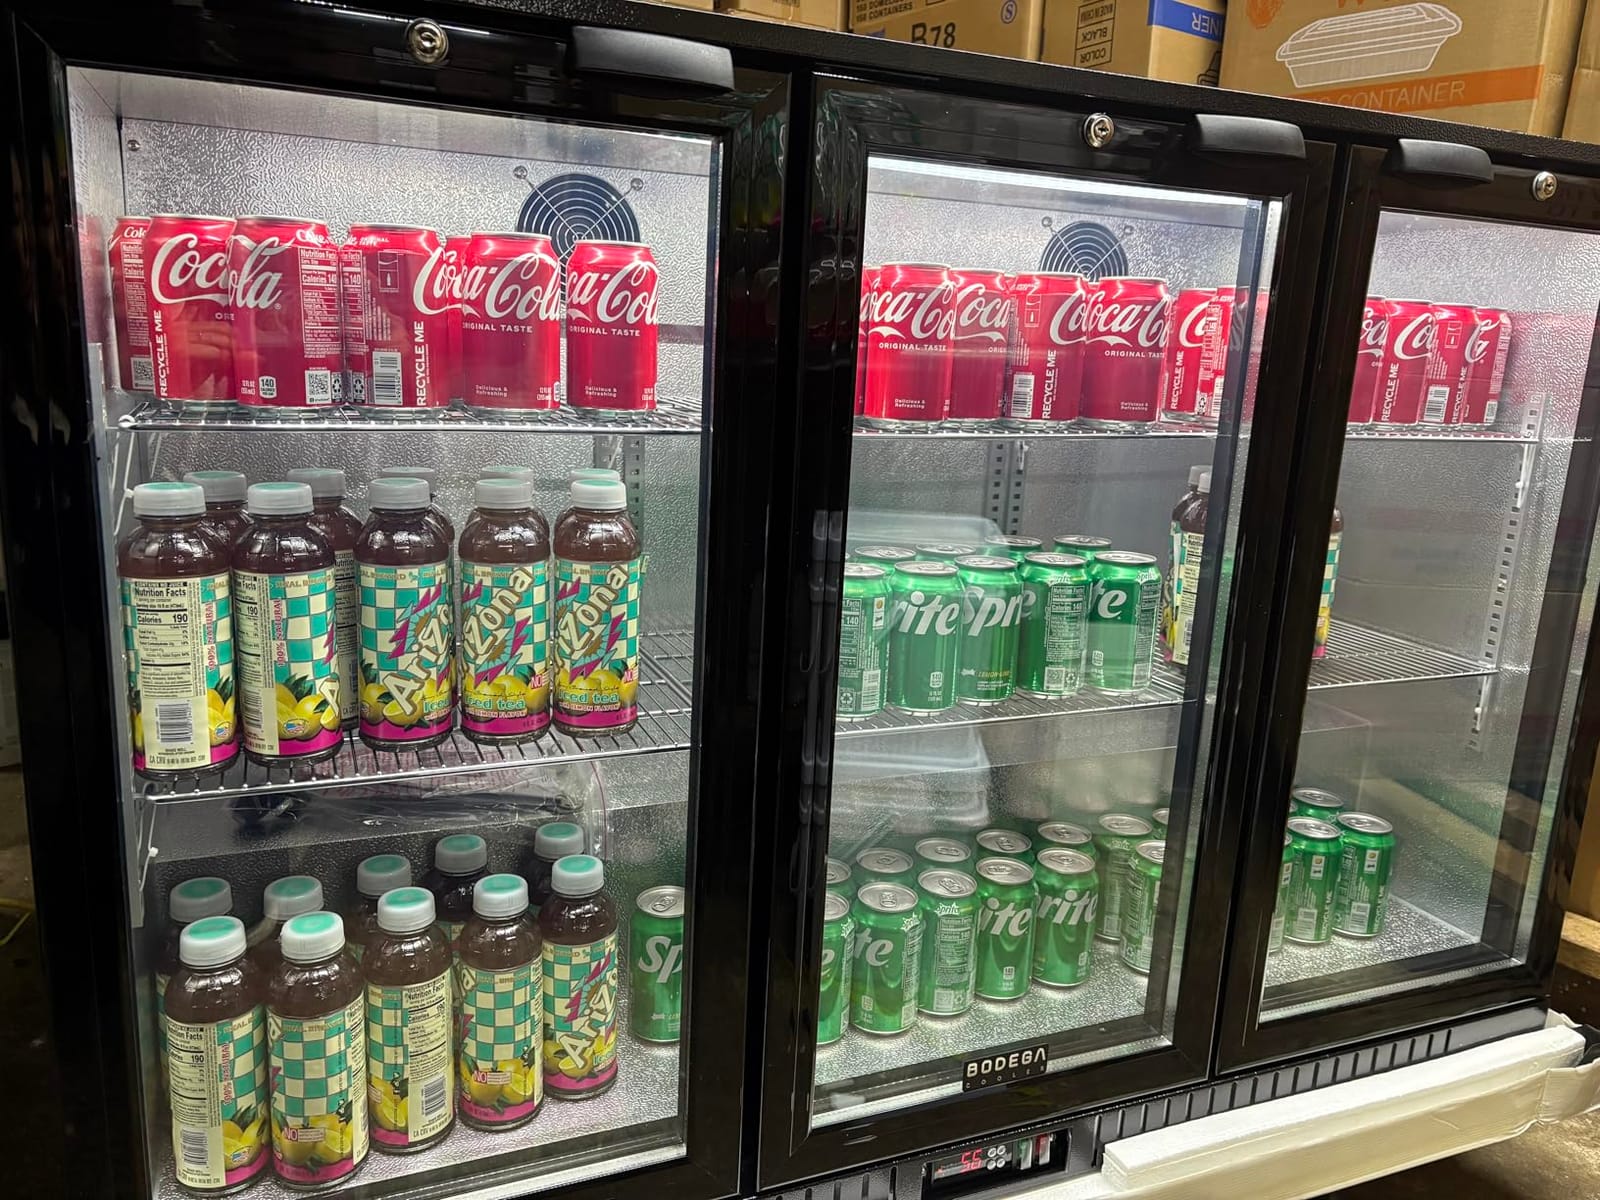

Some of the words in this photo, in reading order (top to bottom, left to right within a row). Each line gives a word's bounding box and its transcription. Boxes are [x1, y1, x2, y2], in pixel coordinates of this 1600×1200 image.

[153, 310, 163, 331] ME
[414, 321, 425, 342] ME
[500, 325, 533, 333] TASTE
[611, 328, 641, 337] TASTE
[879, 342, 921, 351] ORIGINAL
[1047, 349, 1057, 367] ME
[1104, 350, 1146, 358] ORIGINAL
[1176, 351, 1185, 367] ME
[155, 333, 169, 397] RECYCLE
[415, 344, 427, 407] RECYCLE
[261, 379, 275, 388] 140
[1170, 367, 1183, 410] RECYCLE
[1042, 368, 1055, 419] RECYCLE
[1381, 379, 1397, 422] RECYCLE
[1390, 363, 1400, 379] ME
[1452, 382, 1465, 423] RECYCLE
[135, 588, 164, 597] Nutrition
[166, 587, 187, 597] Facts
[247, 606, 258, 615] 190
[138, 615, 162, 624] Calories
[172, 613, 188, 623] 190
[846, 616, 859, 626] 140
[498, 697, 526, 710] tea
[593, 692, 620, 704] tea
[191, 1054, 204, 1063] 190
[966, 1048, 1047, 1078] BODEGA
[473, 1070, 487, 1084] NO
[283, 1127, 298, 1141] NO
